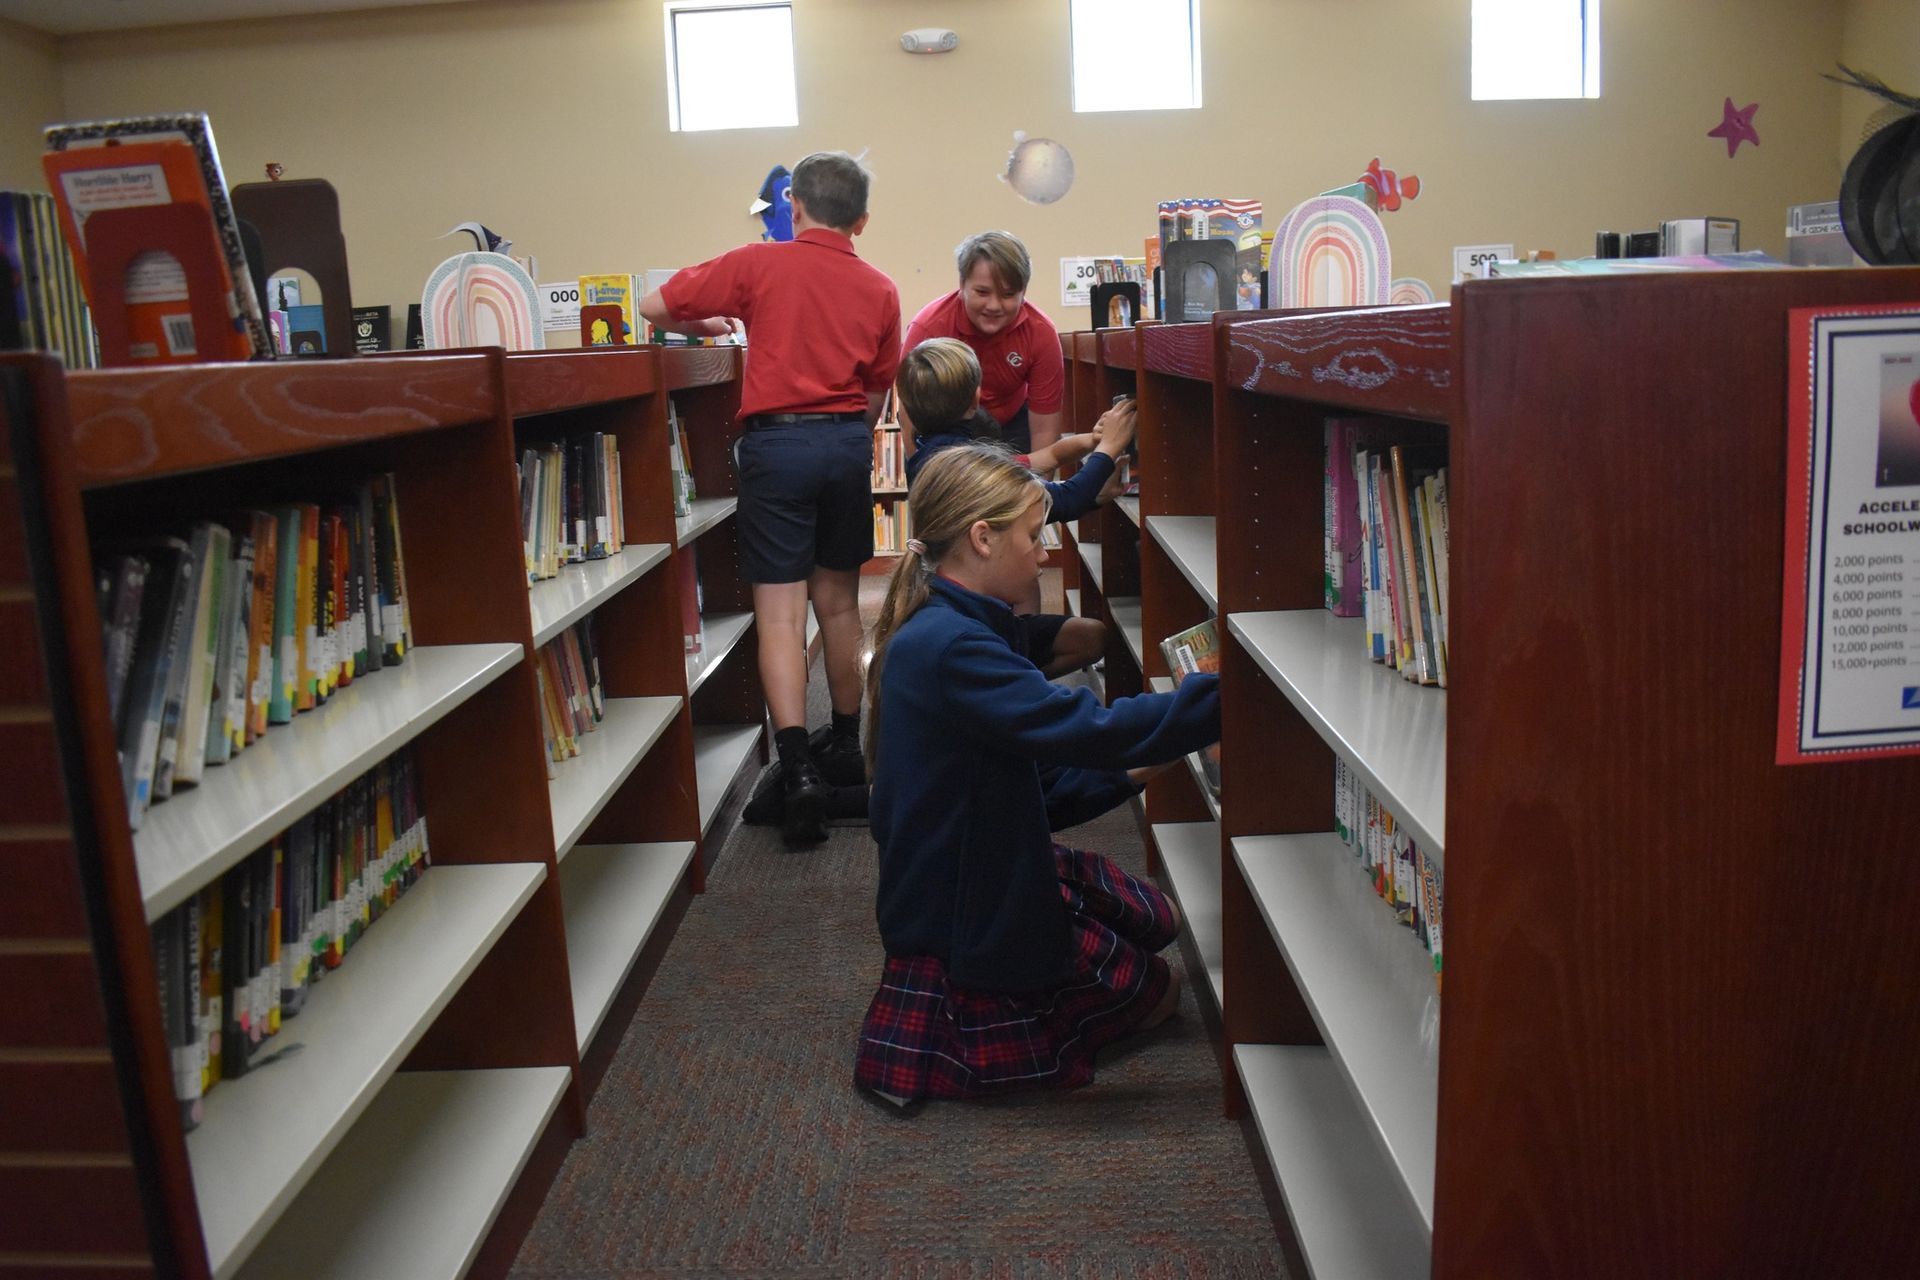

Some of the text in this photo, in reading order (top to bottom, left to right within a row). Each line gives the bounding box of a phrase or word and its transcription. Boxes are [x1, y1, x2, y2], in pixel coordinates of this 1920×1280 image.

[550, 290, 579, 303] 000
[1858, 500, 1920, 515] ACCELE
[1833, 554, 1904, 570] 2,000 points
[1833, 571, 1903, 587] 4,000 points
[1832, 588, 1903, 604] 6,000 points
[1832, 605, 1902, 622] 8,000 points
[1832, 622, 1908, 639] 10,000 points
[1832, 639, 1904, 656] 12,000 points
